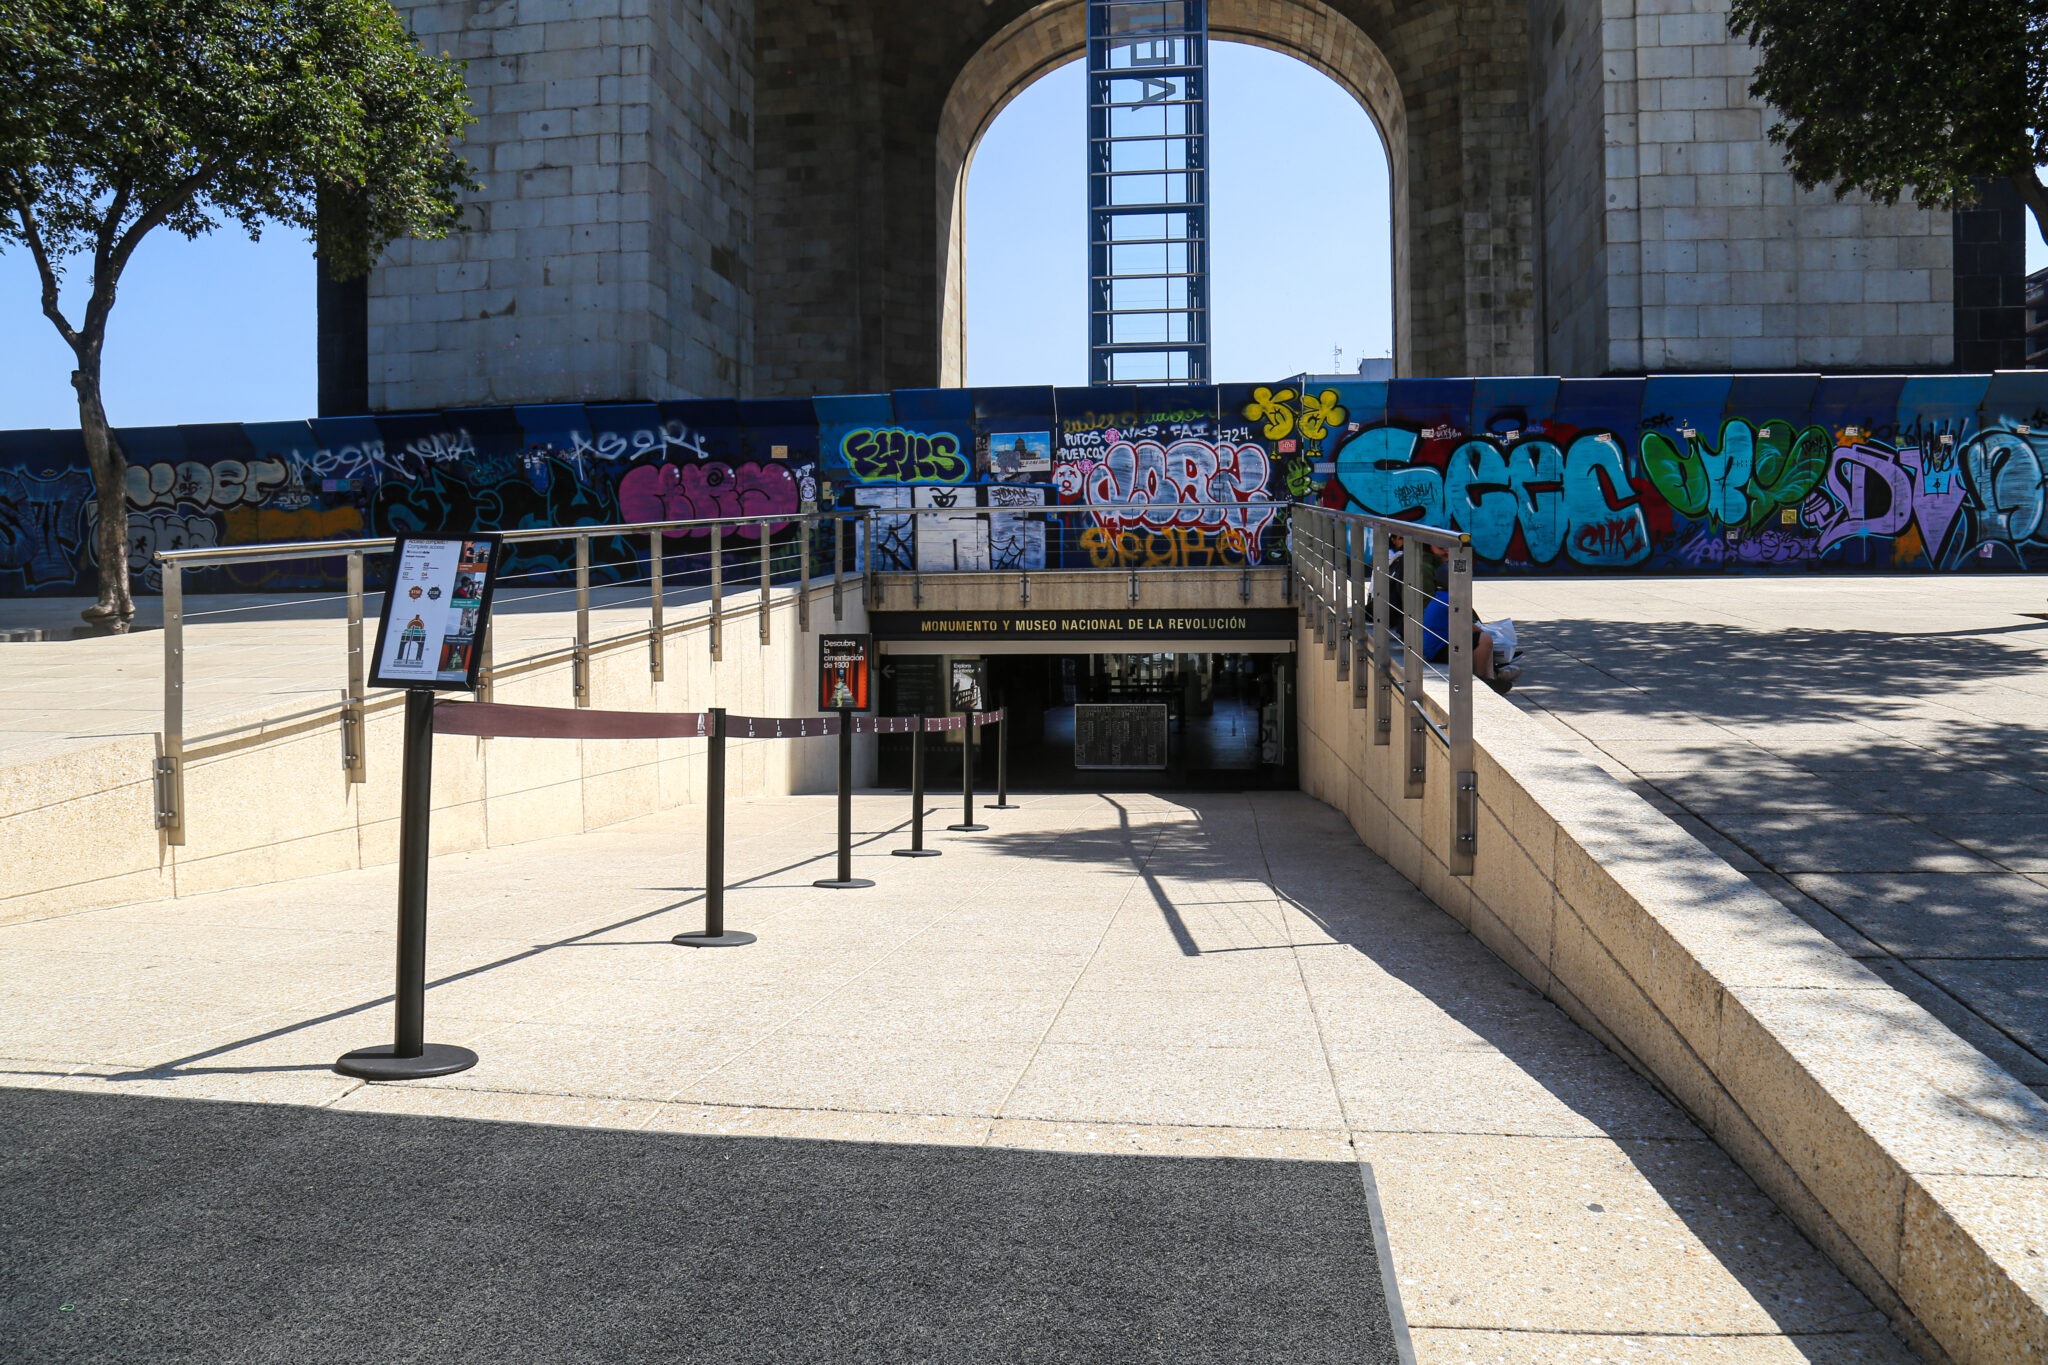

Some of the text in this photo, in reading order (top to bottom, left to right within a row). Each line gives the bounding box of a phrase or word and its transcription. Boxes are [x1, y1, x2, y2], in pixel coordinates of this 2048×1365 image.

[921, 616, 1247, 632] MONUMENTO Y MUSEO NACIONAL DE LA REVOLUCIÓN
[823, 654, 865, 662] cimentación
